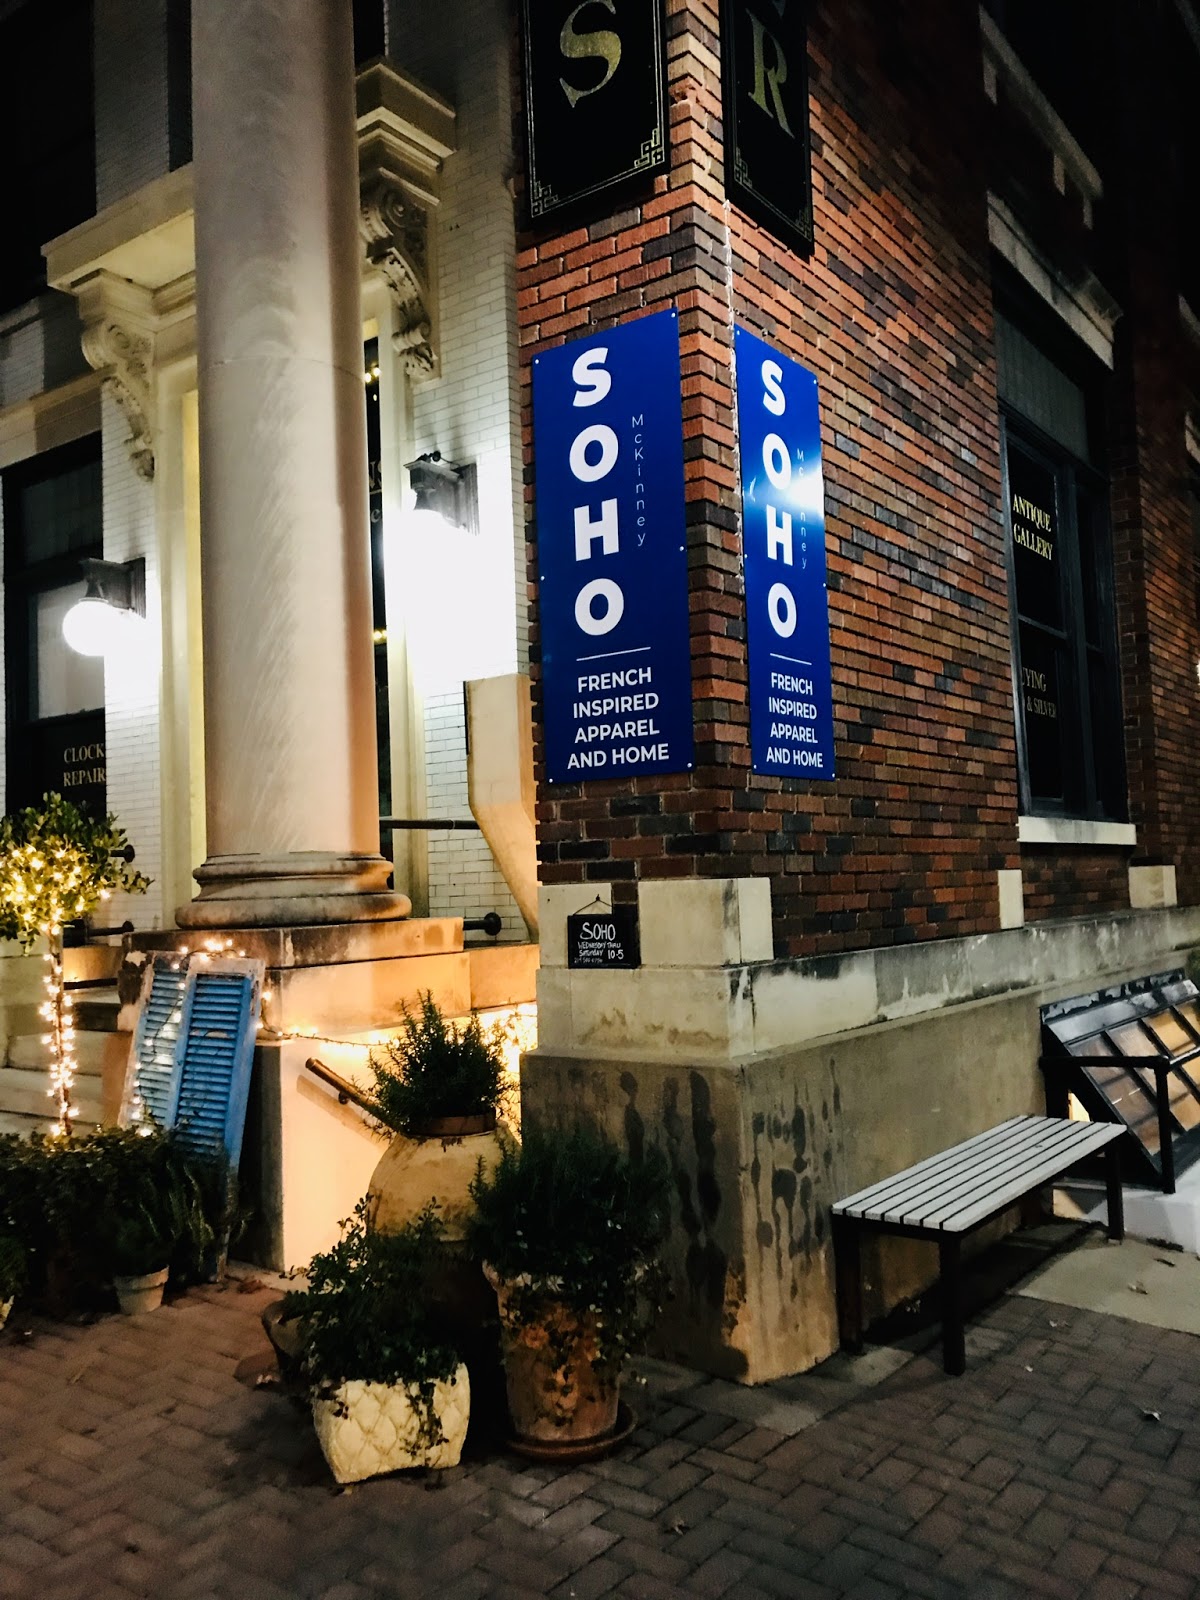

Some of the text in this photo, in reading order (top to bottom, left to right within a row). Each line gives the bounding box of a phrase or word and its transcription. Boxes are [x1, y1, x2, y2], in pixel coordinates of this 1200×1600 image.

[745, 0, 796, 139] R
[568, 346, 625, 637] SOHO
[631, 413, 646, 547] McKinney
[761, 359, 797, 639] SOHO
[796, 447, 808, 570] Mcnney
[1013, 493, 1052, 533] ANTIQUE
[1013, 523, 1053, 561] GALLERY
[577, 666, 652, 694] FRENCH
[771, 671, 813, 696] FRENCH
[573, 692, 660, 719] INSPIRED
[768, 696, 818, 720] INSPIRED
[574, 718, 660, 744] APPAREL
[770, 722, 819, 744] APPAREL
[567, 743, 670, 770] AND HOME
[766, 746, 824, 769] AND HOME
[63, 767, 106, 787] REPAIR
[579, 922, 616, 941] SOHO
